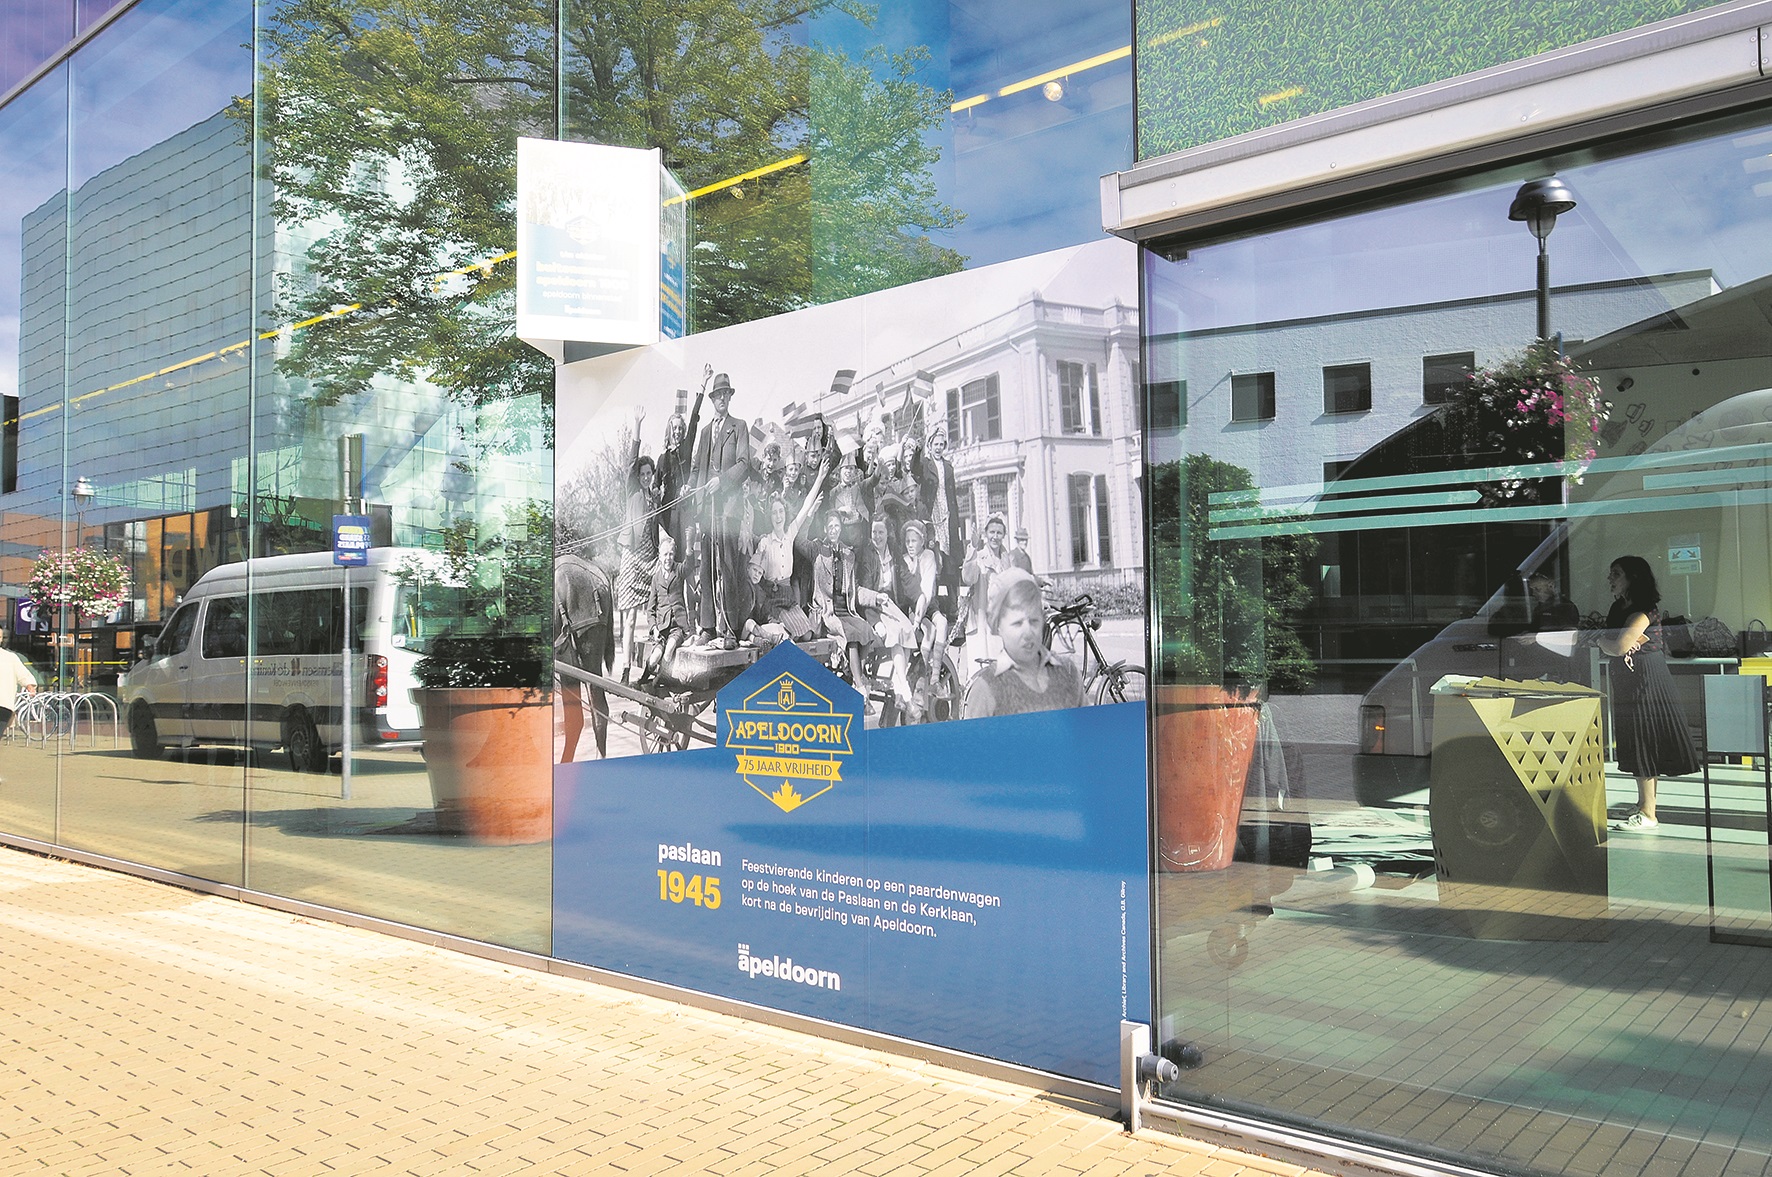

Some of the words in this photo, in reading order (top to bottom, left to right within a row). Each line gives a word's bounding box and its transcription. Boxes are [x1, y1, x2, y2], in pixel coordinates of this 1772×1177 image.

[735, 721, 842, 744] APELDOORN
[743, 759, 754, 772] 75
[756, 760, 782, 773] JAAR
[785, 762, 833, 777] VRIJHEID
[657, 842, 722, 867] paslaan
[656, 869, 722, 910] 1945
[741, 859, 813, 880] Feestvierende
[816, 869, 864, 888] kinderen
[865, 878, 881, 892] op
[883, 880, 905, 893] een
[908, 884, 1001, 908] paardenwagen
[741, 879, 754, 892] op
[756, 879, 770, 892] de
[772, 880, 797, 896] hoek
[799, 887, 819, 900] van
[821, 888, 835, 902] de
[838, 890, 881, 909] Paslaan
[883, 899, 898, 912] en
[901, 900, 916, 914] de
[920, 902, 977, 927] Kerklaan,
[741, 893, 762, 909] kort
[764, 899, 777, 911] na
[779, 900, 792, 913] de
[795, 902, 848, 926] bevrijding
[851, 912, 870, 927] van
[873, 915, 937, 938] Apeldoorn.
[1120, 973, 1128, 994] Library
